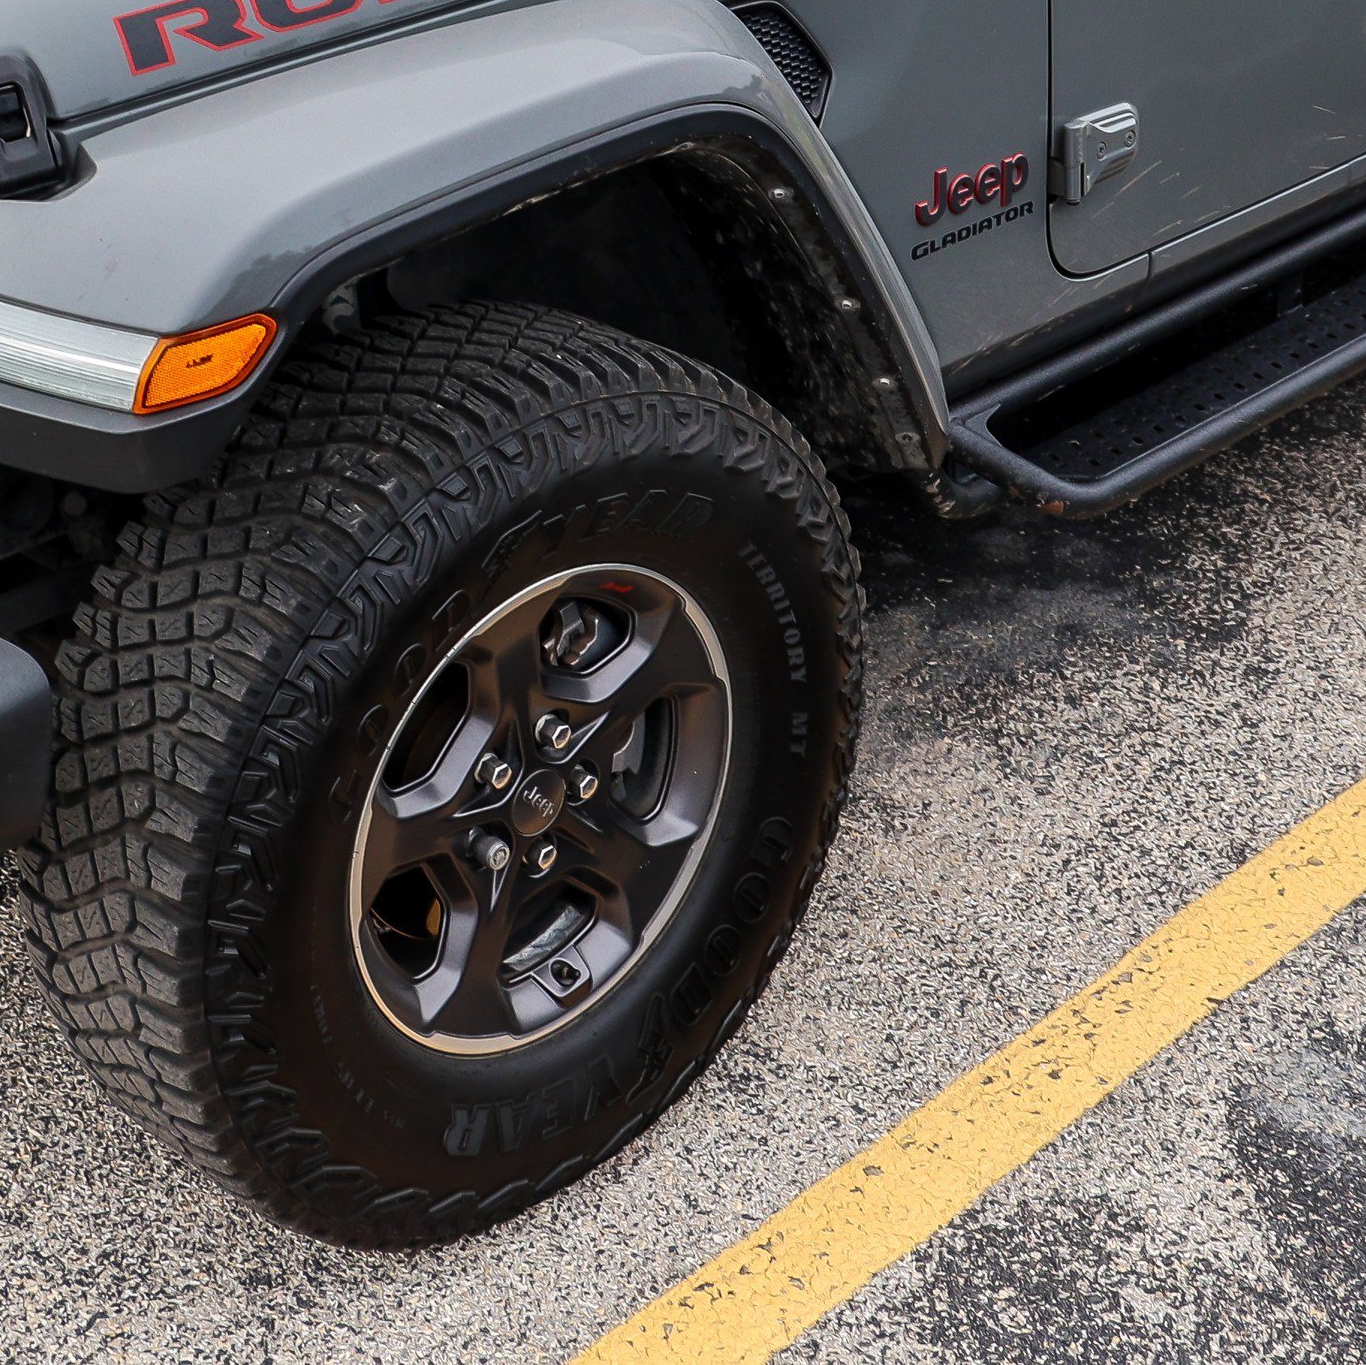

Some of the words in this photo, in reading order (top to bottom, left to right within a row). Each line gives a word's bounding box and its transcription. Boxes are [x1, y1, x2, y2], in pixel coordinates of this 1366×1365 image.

[914, 151, 1030, 227] Jeep
[910, 200, 1035, 261] GLADIATOR
[737, 541, 808, 683] TERRITORY
[789, 711, 809, 757] MT
[522, 785, 555, 818] Jeep
